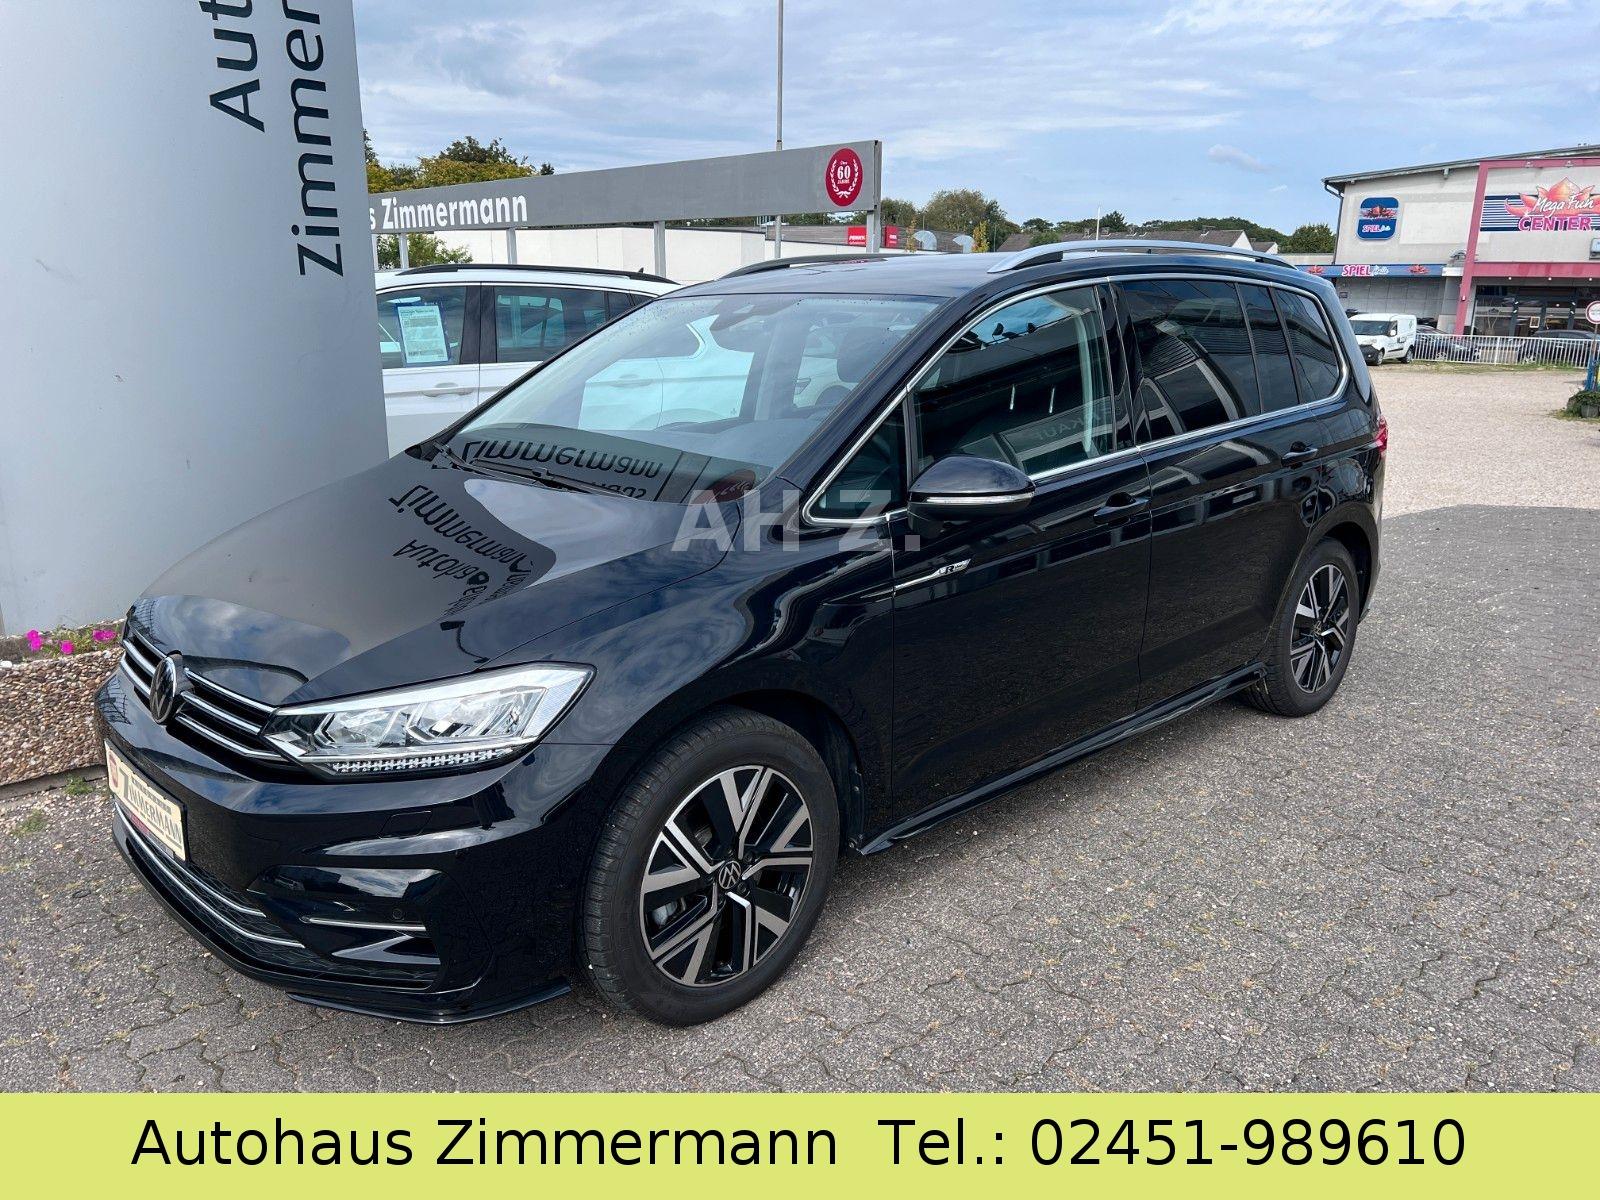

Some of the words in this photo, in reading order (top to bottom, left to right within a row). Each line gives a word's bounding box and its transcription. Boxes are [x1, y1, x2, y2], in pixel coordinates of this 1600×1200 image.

[837, 165, 851, 180] 60
[381, 195, 528, 230] Zimmermann
[1533, 198, 1564, 218] Mega
[1567, 192, 1594, 209] Fun
[1518, 216, 1592, 231] CENTER
[1341, 264, 1374, 277] SPIEL
